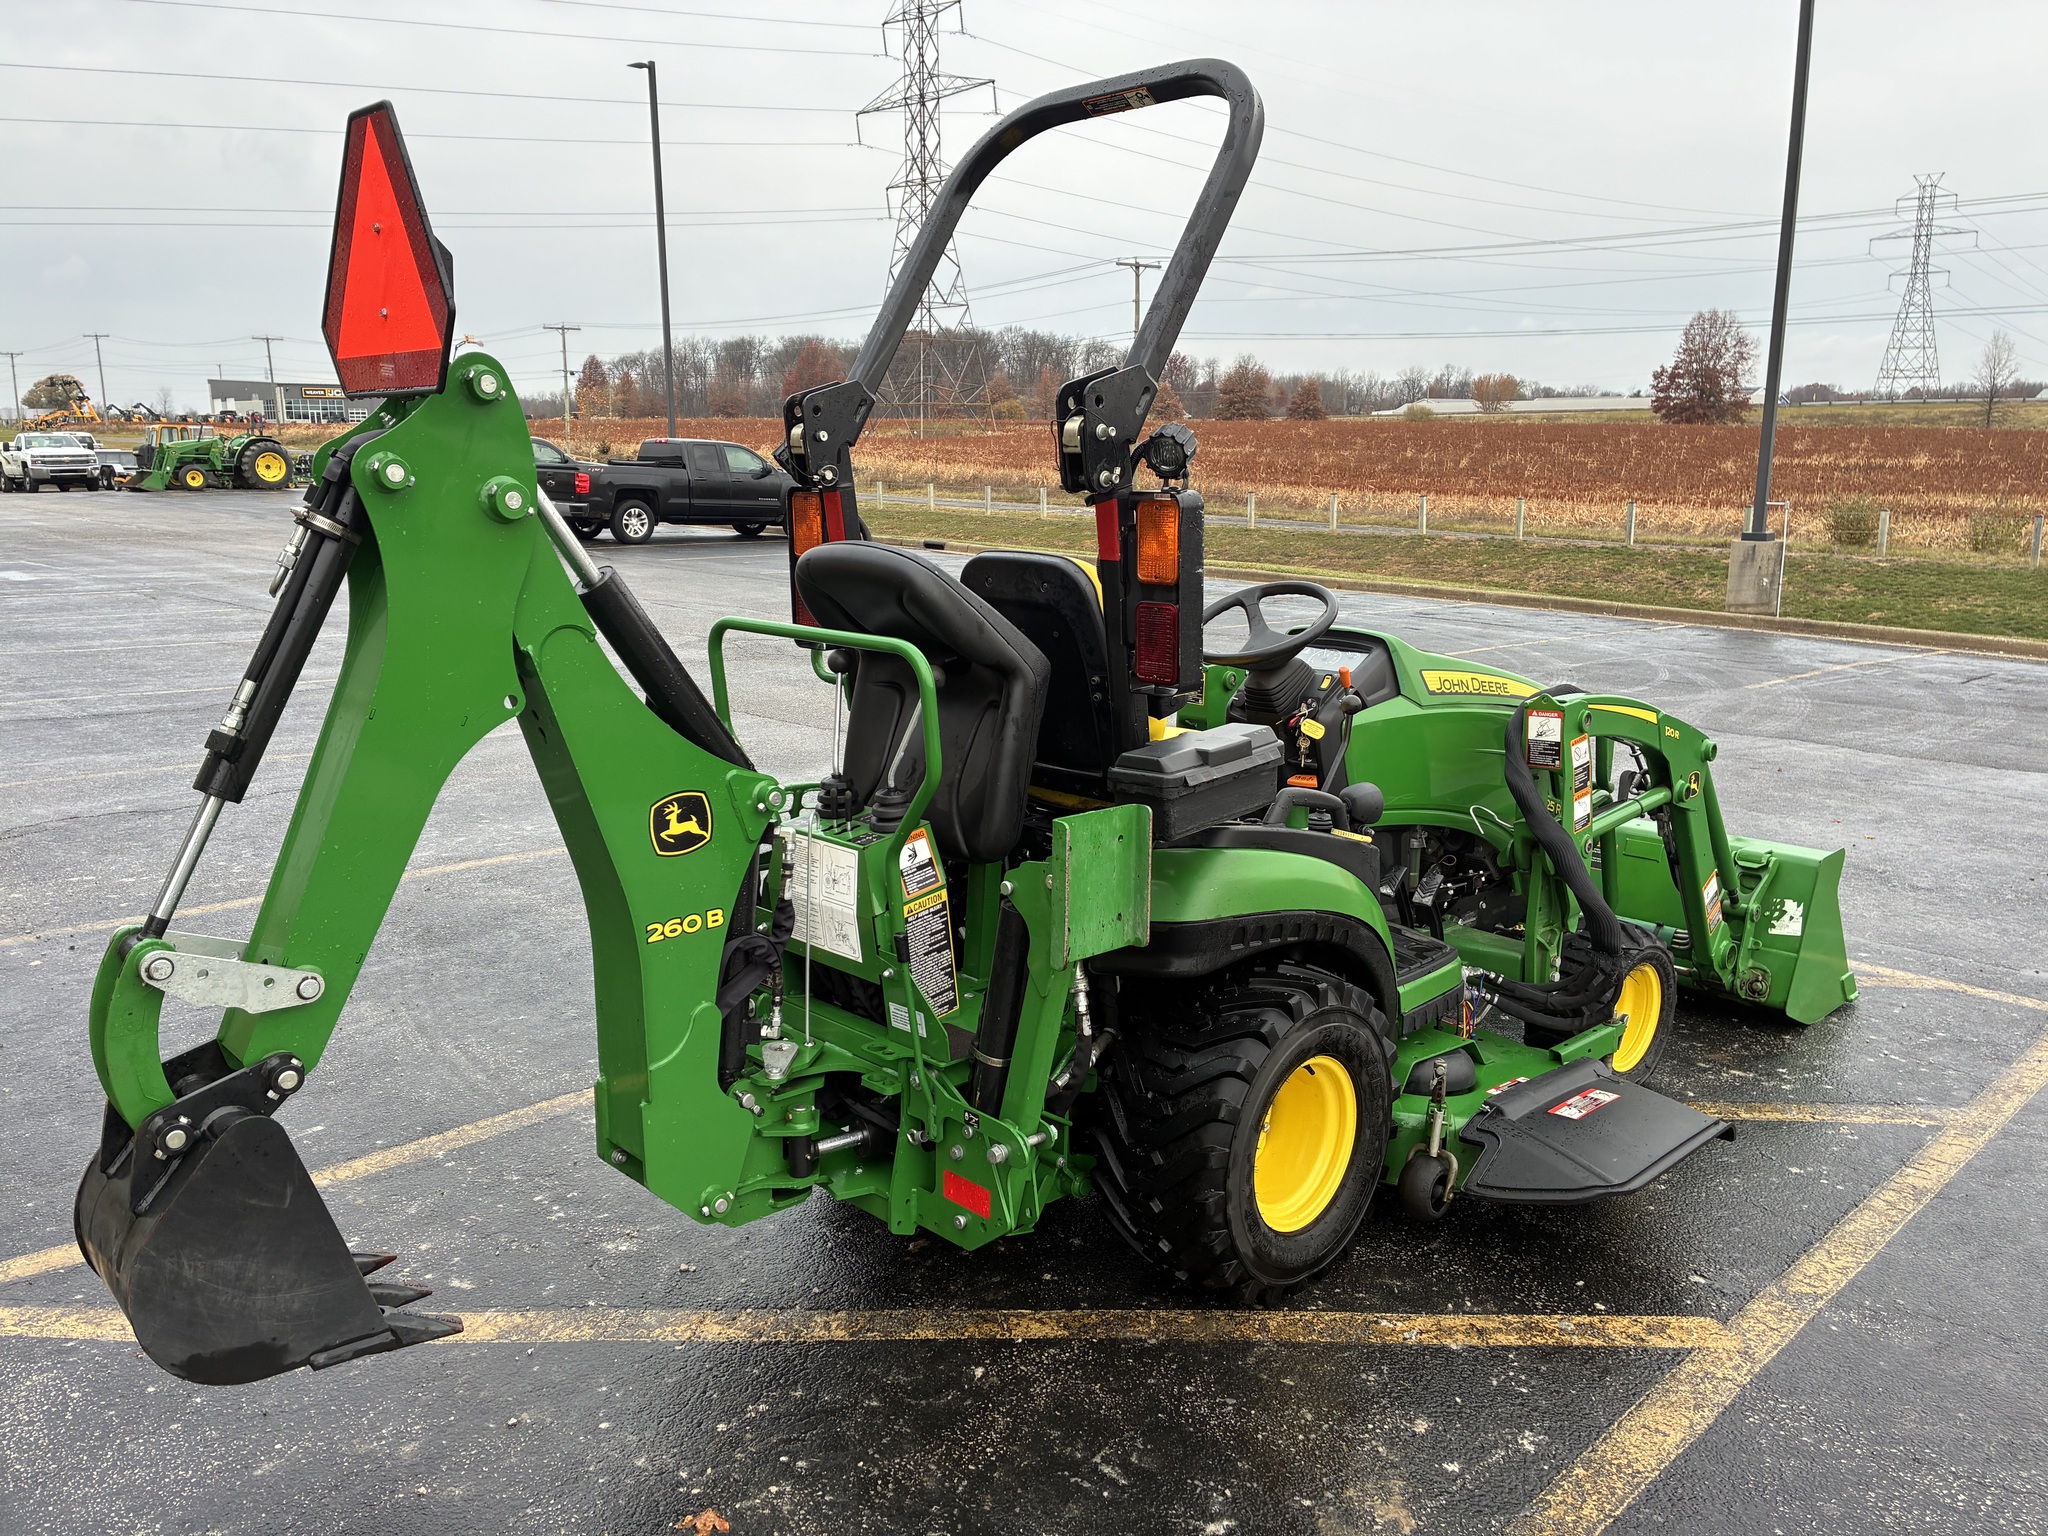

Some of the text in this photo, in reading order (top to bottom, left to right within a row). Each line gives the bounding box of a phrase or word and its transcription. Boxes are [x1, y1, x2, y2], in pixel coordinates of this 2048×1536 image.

[1436, 676, 1510, 694] JOHN DEERE
[913, 892, 943, 911] CAUTION
[646, 907, 725, 945] 260 B
